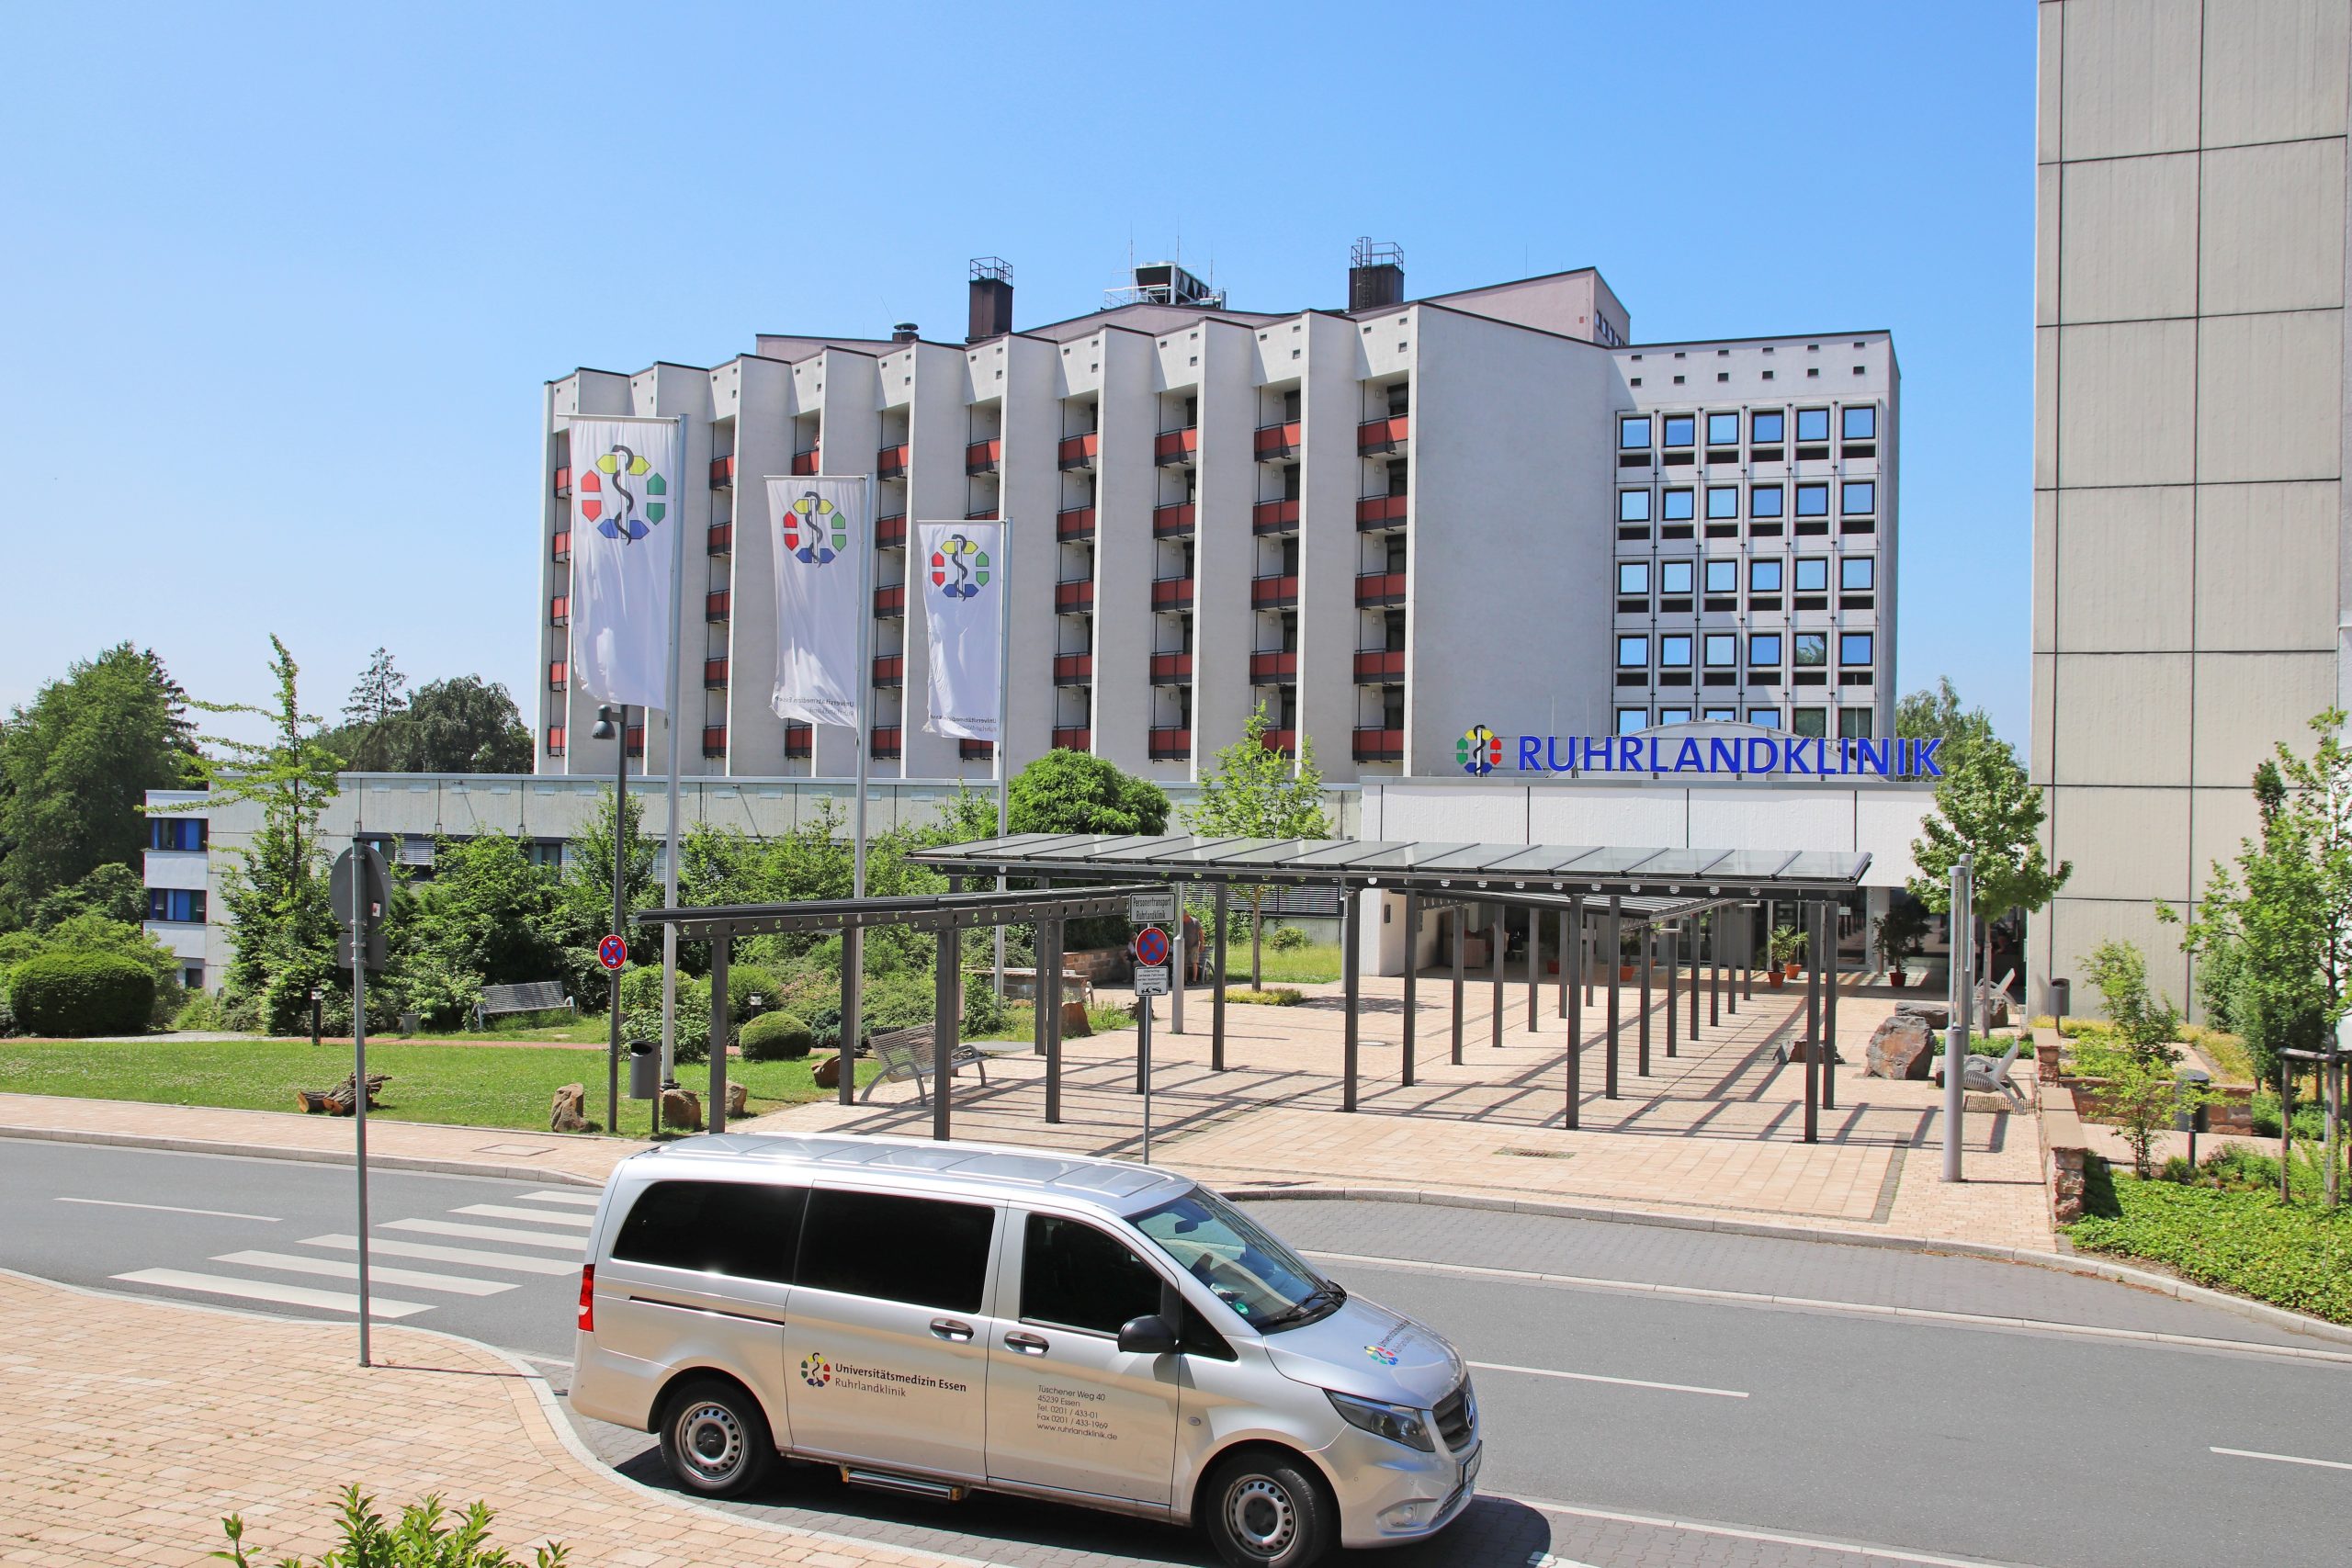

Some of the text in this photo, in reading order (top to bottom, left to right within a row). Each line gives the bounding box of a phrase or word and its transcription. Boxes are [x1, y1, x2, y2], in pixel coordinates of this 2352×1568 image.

[1518, 735, 1943, 777] RUHRLANDKLINIK
[835, 1363, 967, 1392] Universitätsmedizin Essen
[835, 1378, 906, 1397] Ruhrlandklinik
[1037, 1394, 1080, 1407] 45239 Essen
[1077, 1391, 1094, 1401] Weg
[1037, 1404, 1049, 1413] Tel.
[1050, 1405, 1067, 1415] 0201
[1075, 1409, 1098, 1419] 433-01
[1037, 1414, 1050, 1422] Fax
[1051, 1416, 1068, 1424] 0201
[1075, 1419, 1108, 1429] 433-1969
[1037, 1424, 1117, 1439] www.ruhrlandklinik.de
